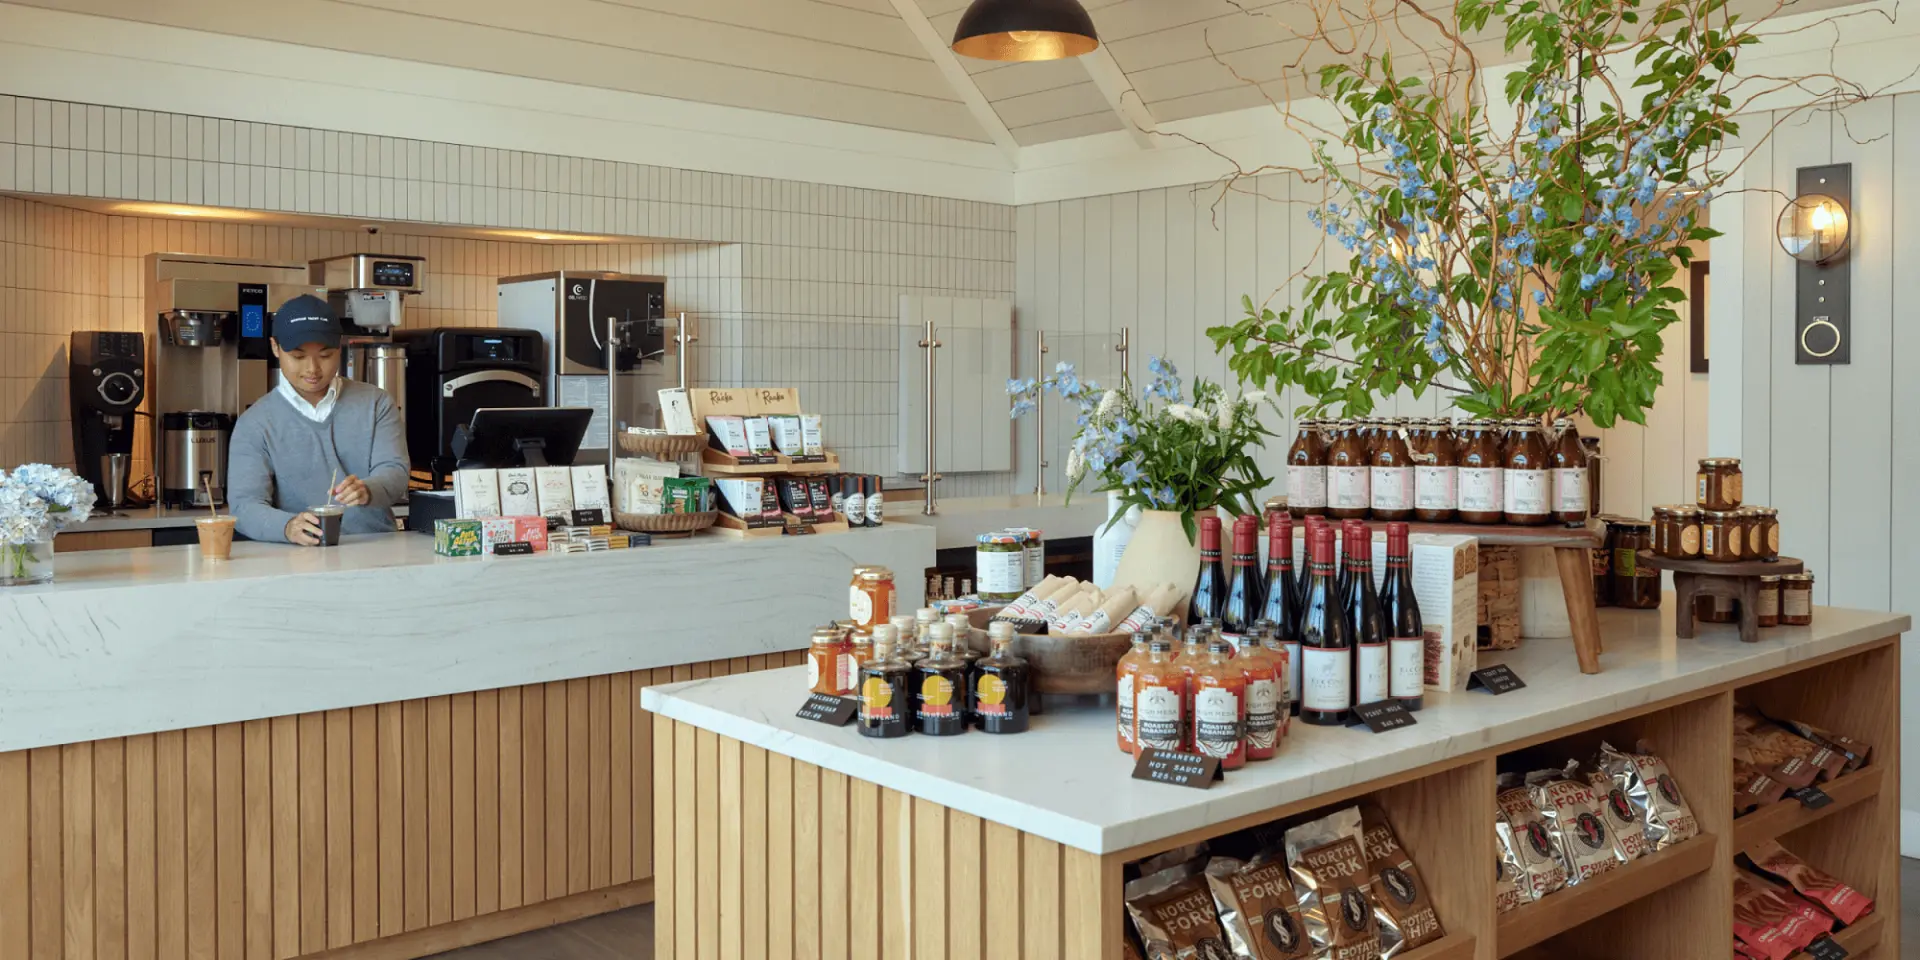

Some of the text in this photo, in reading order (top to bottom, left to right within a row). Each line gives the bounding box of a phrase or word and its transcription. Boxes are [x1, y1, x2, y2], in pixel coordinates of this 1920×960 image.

[1153, 751, 1202, 763] HABANERO
[1151, 771, 1188, 783] $25.00
[1173, 764, 1204, 775] SAUCE
[1506, 799, 1538, 816] FORK
[1555, 788, 1594, 809] FORK
[1364, 827, 1390, 848] RTH
[1308, 844, 1355, 869] NORTH
[1231, 865, 1281, 888] NORTH
[1315, 855, 1363, 883] FORK
[1238, 878, 1288, 904] FORK
[1156, 888, 1209, 921] NORTH
[1165, 902, 1217, 935] FORK
